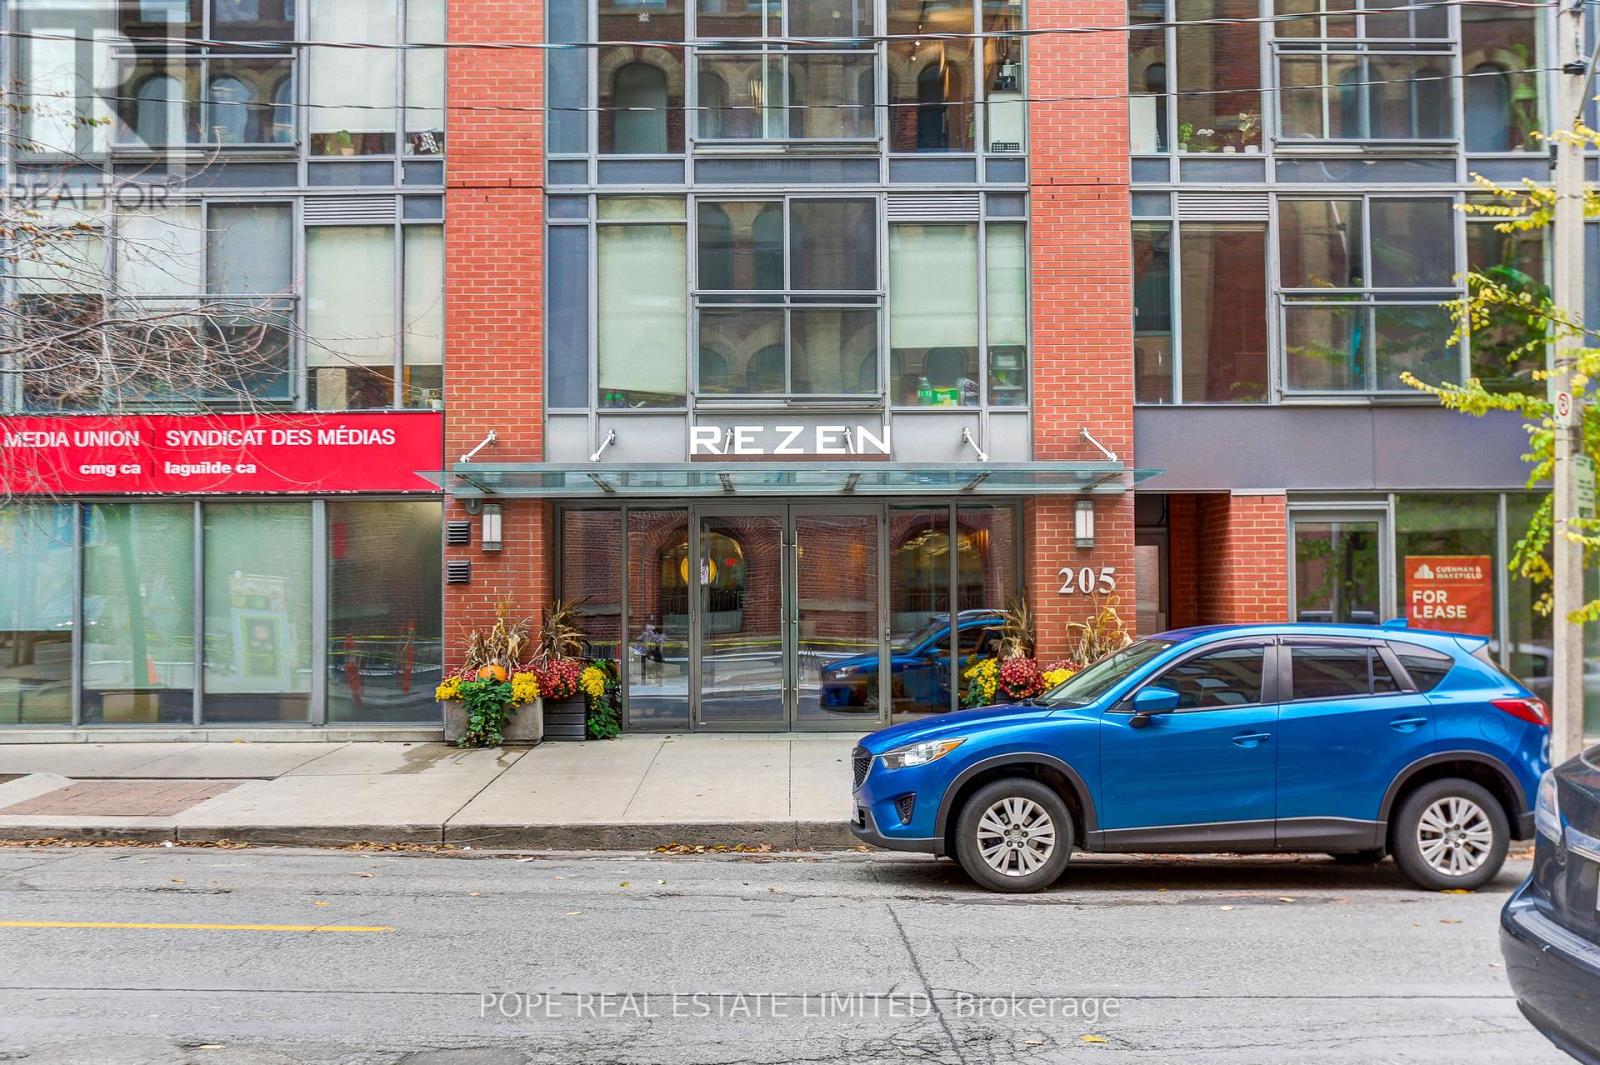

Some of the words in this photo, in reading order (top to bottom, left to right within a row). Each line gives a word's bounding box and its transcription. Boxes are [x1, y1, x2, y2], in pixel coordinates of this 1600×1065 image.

[3, 431, 70, 448] MEDIA
[74, 430, 140, 447] UNION
[165, 429, 266, 447] SYNDICAT
[271, 429, 313, 446] DES
[317, 425, 396, 446] MÉDIAS
[689, 425, 891, 454] REZEN
[1058, 567, 1116, 594] 205
[1412, 590, 1448, 604] FOR
[1413, 605, 1467, 619] LEASE
